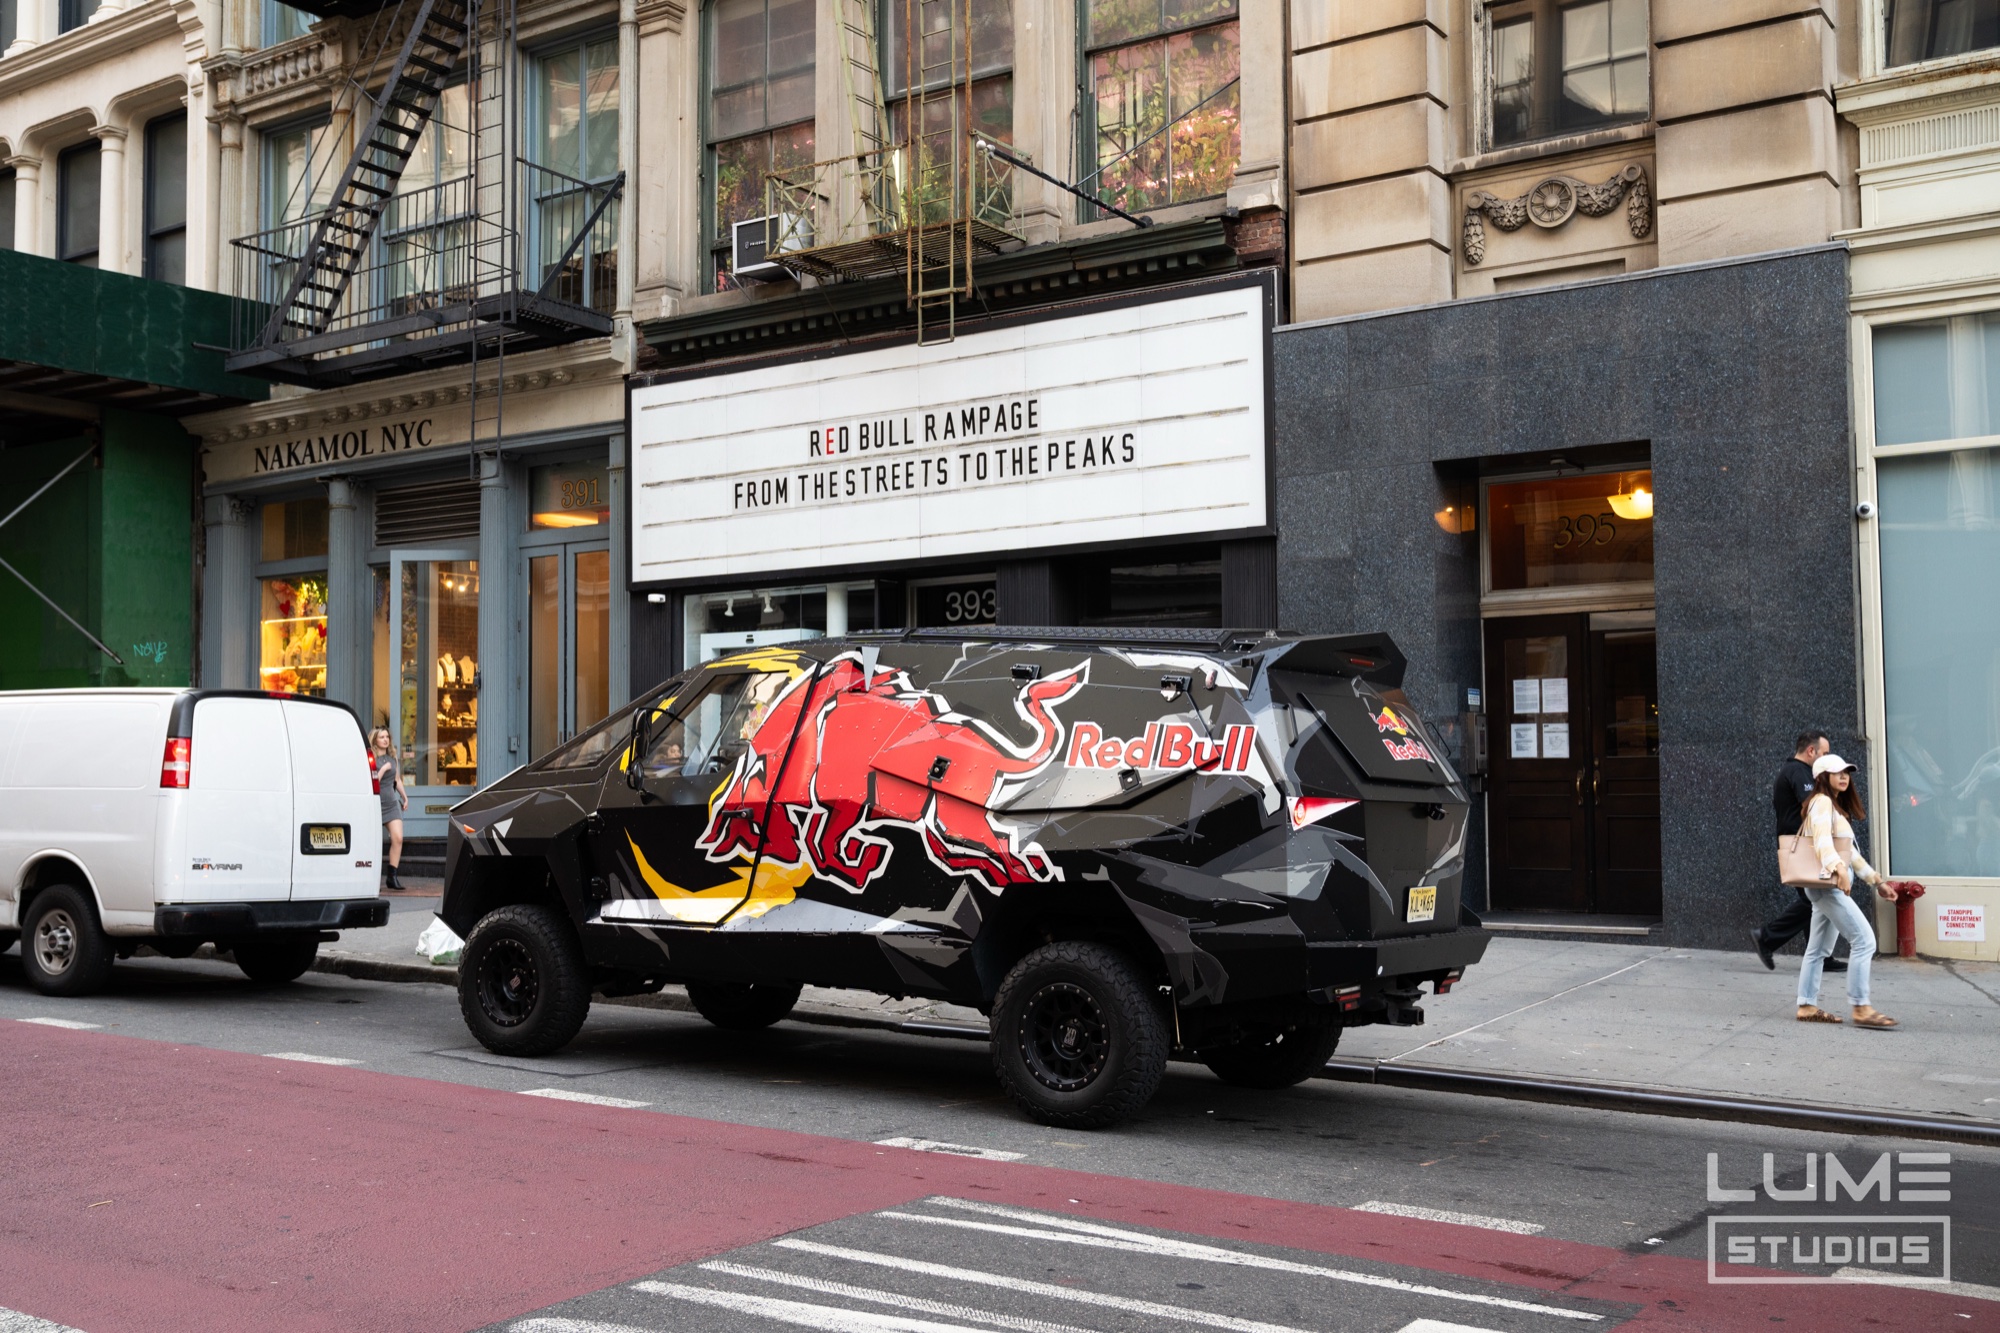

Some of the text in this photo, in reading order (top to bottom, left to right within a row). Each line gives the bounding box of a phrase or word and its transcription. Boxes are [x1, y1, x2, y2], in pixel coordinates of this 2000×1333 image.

[254, 419, 432, 473] NAKAMOL NYC
[810, 399, 1038, 457] RED BULL RAMPAGE
[561, 478, 601, 509] 391
[734, 433, 1134, 509] FROM THE STREETS TO THE PEAKS
[1553, 512, 1616, 549] 395
[945, 588, 996, 621] 393
